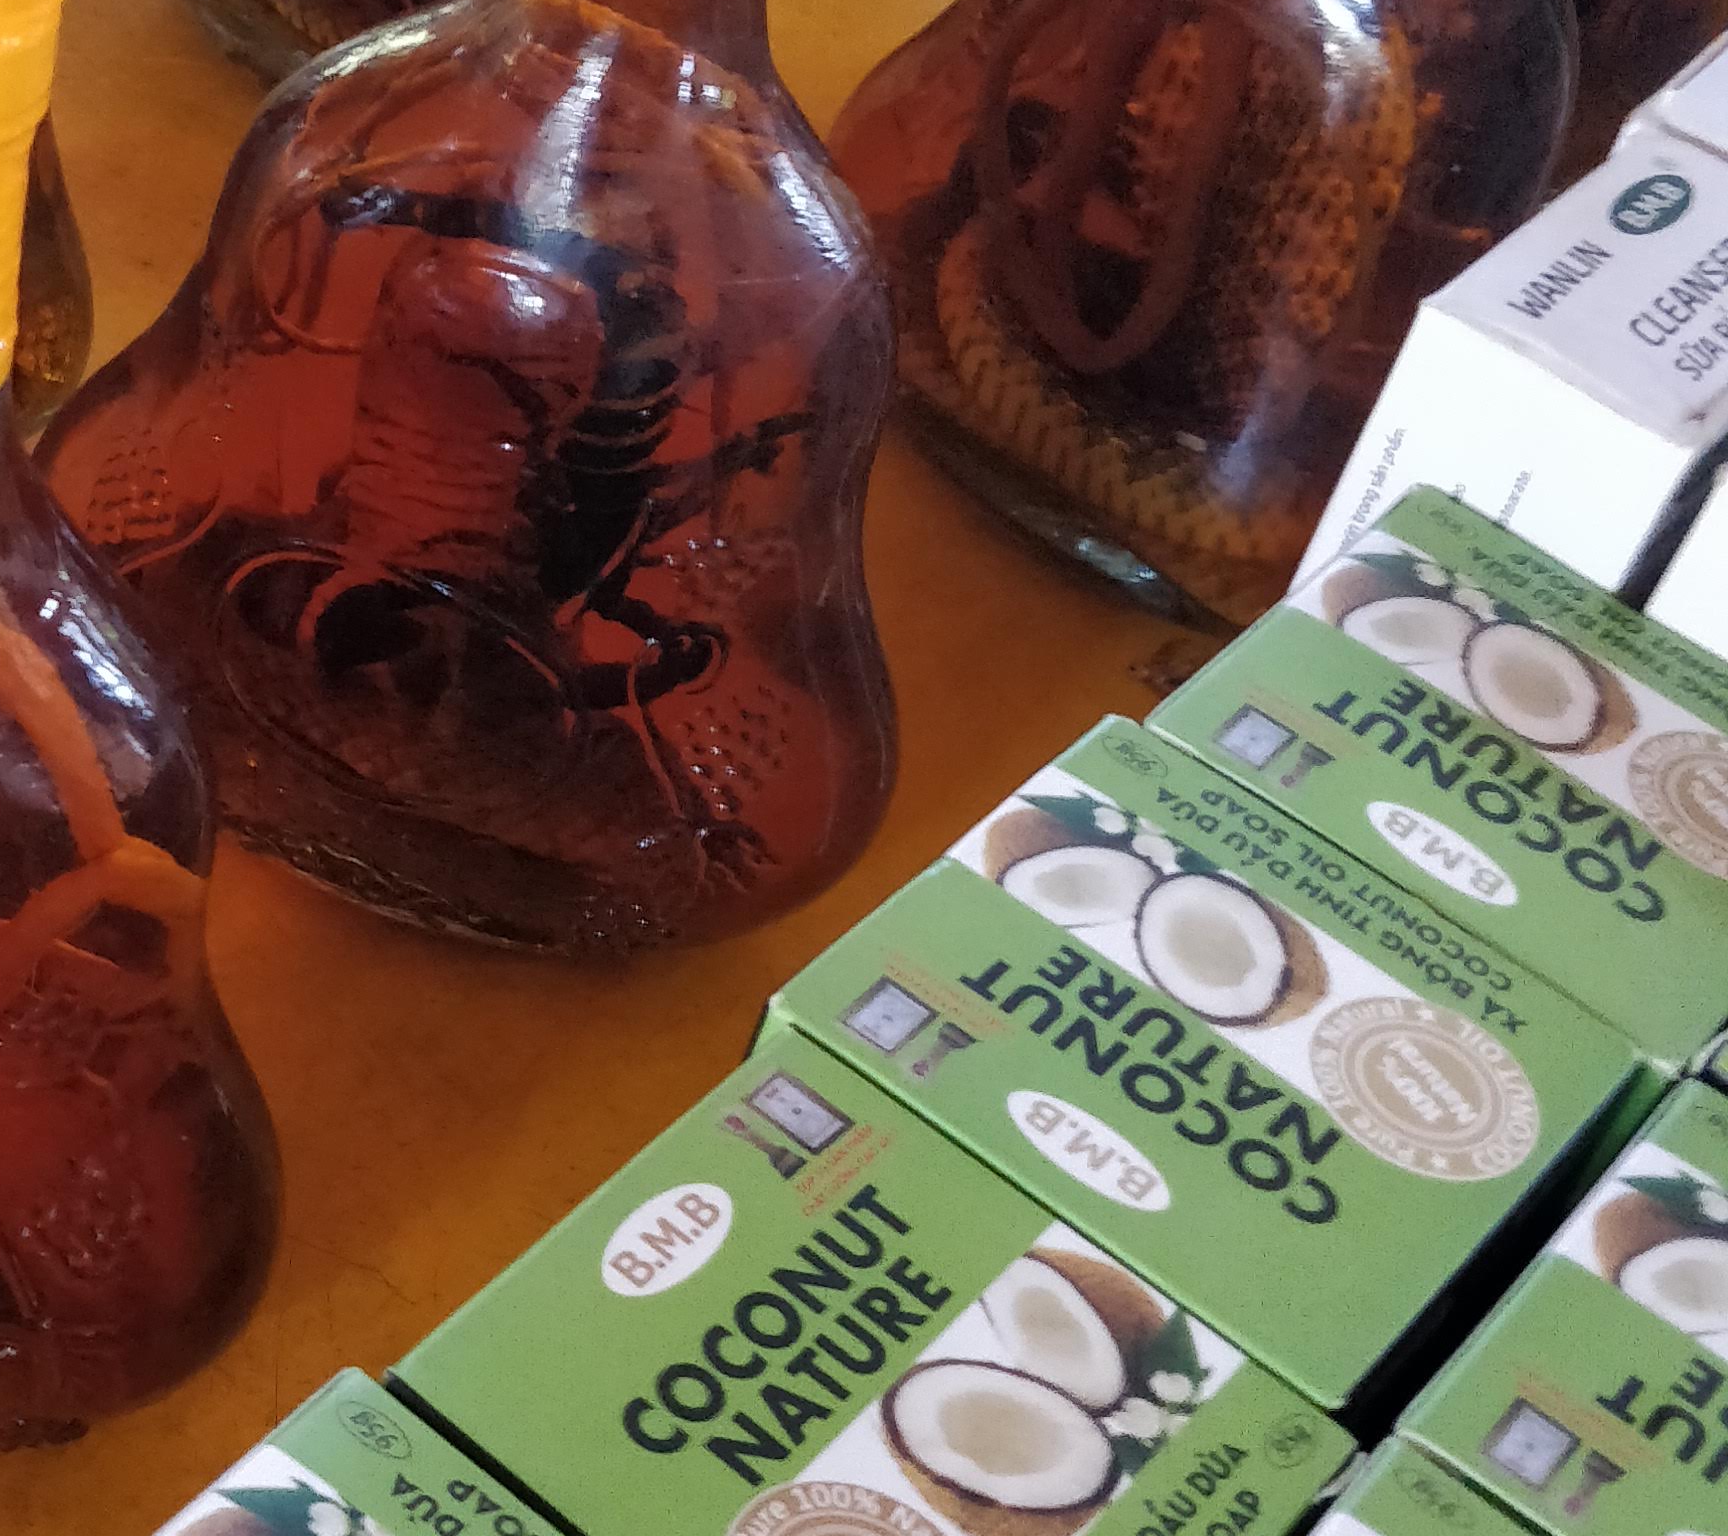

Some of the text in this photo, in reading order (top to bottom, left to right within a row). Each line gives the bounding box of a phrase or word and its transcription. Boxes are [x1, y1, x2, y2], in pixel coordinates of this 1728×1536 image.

[1312, 689, 1666, 924] COCONUT
[1380, 678, 1663, 873] NATURE
[1199, 787, 1513, 993] COCONUT OIL SOAP
[1294, 875, 1371, 937] TINH
[958, 957, 1341, 1226] COCONUT
[1024, 1098, 1157, 1203] B.M.B
[1034, 943, 1342, 1166] NATURE
[608, 1192, 721, 1289] B.M.B
[621, 1183, 912, 1455] COCONUT
[703, 1254, 954, 1488] NATURE
